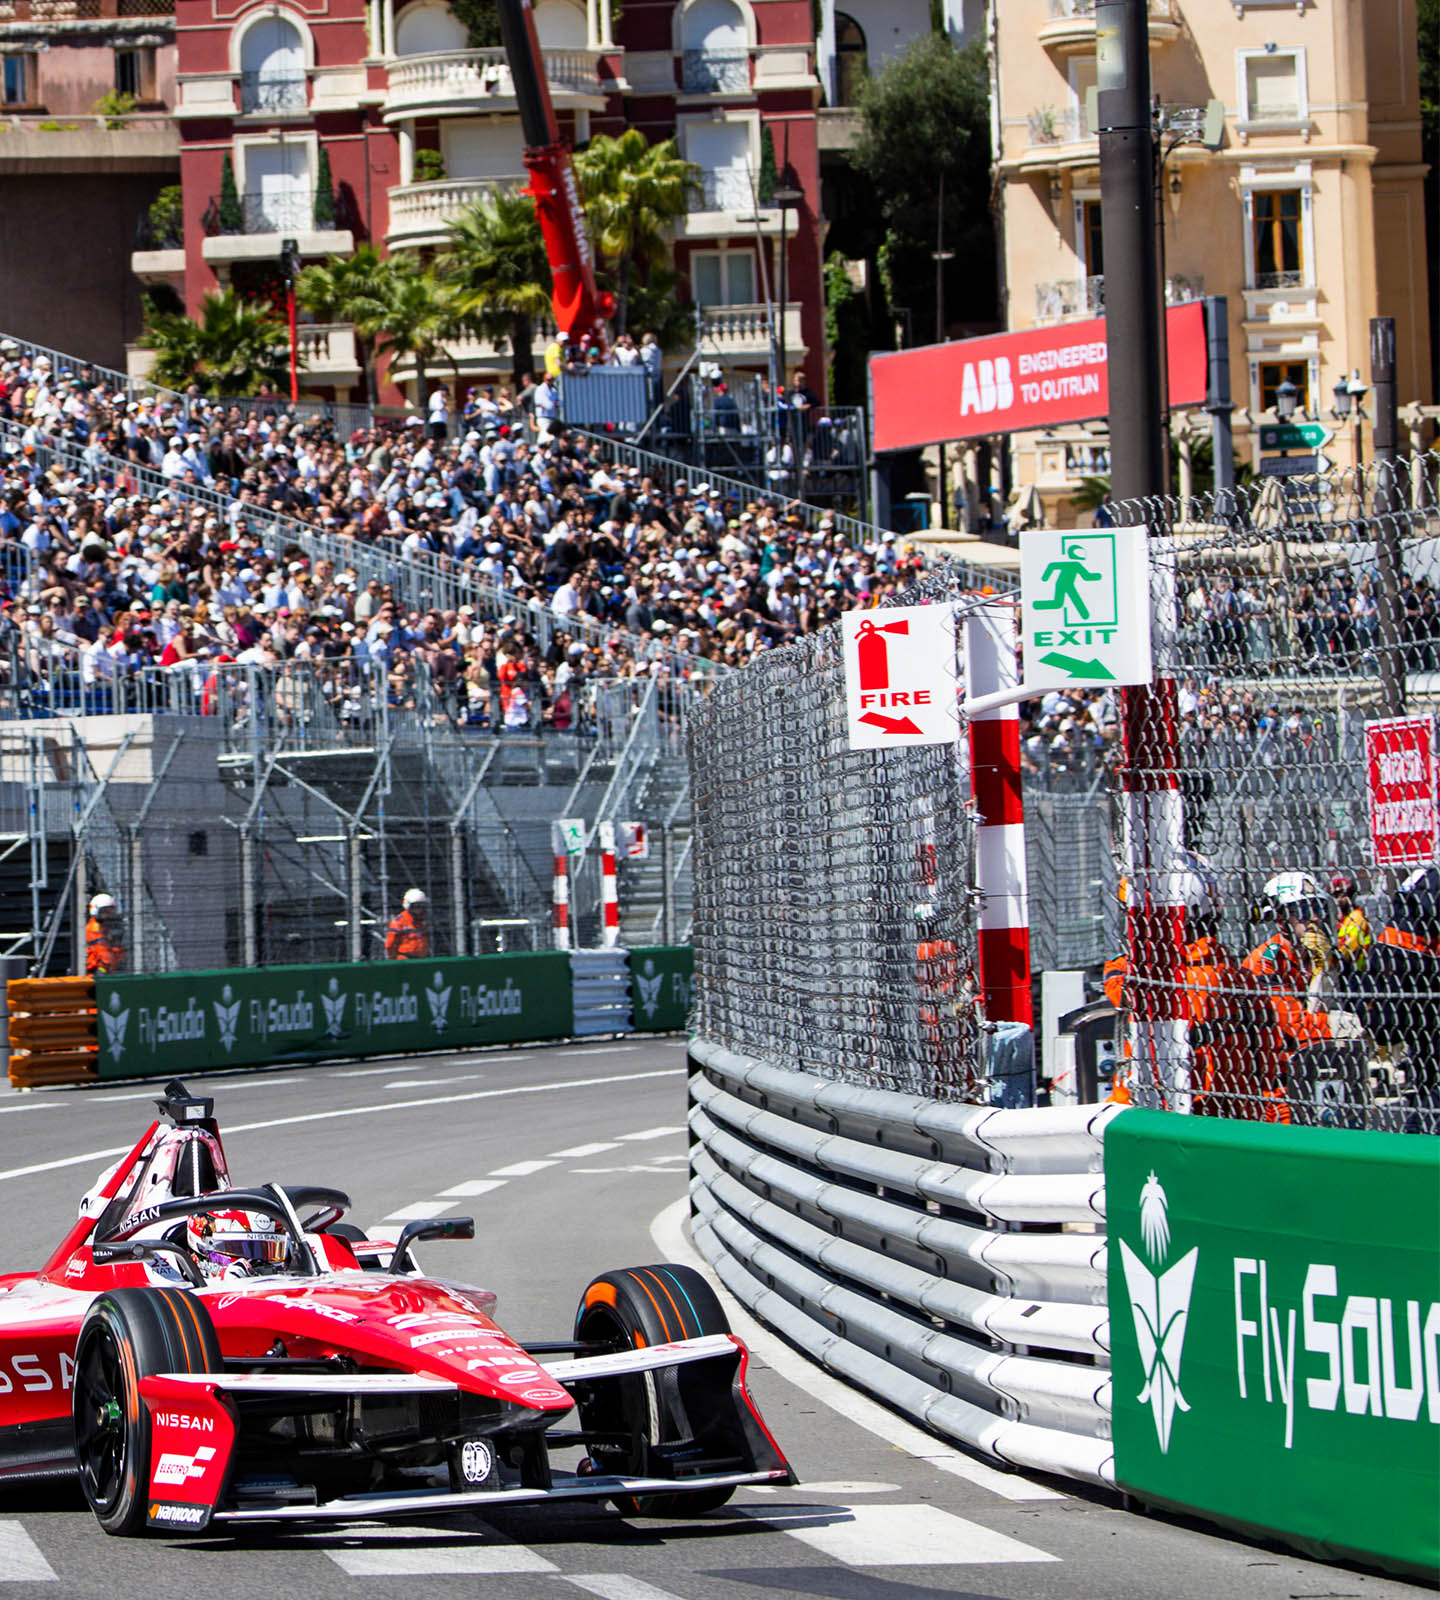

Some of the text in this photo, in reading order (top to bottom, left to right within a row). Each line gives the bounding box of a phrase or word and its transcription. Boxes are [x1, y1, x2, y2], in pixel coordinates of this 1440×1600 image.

[1018, 341, 1108, 376] ENGINEERED
[960, 356, 1015, 417] ABB
[1020, 373, 1100, 404] TO OUTRUN
[1033, 628, 1118, 647] EXIT
[859, 690, 932, 709] FIRE
[119, 1206, 160, 1233] NISSAN
[387, 1312, 482, 1331] 23
[156, 1412, 214, 1432] NISSAN
